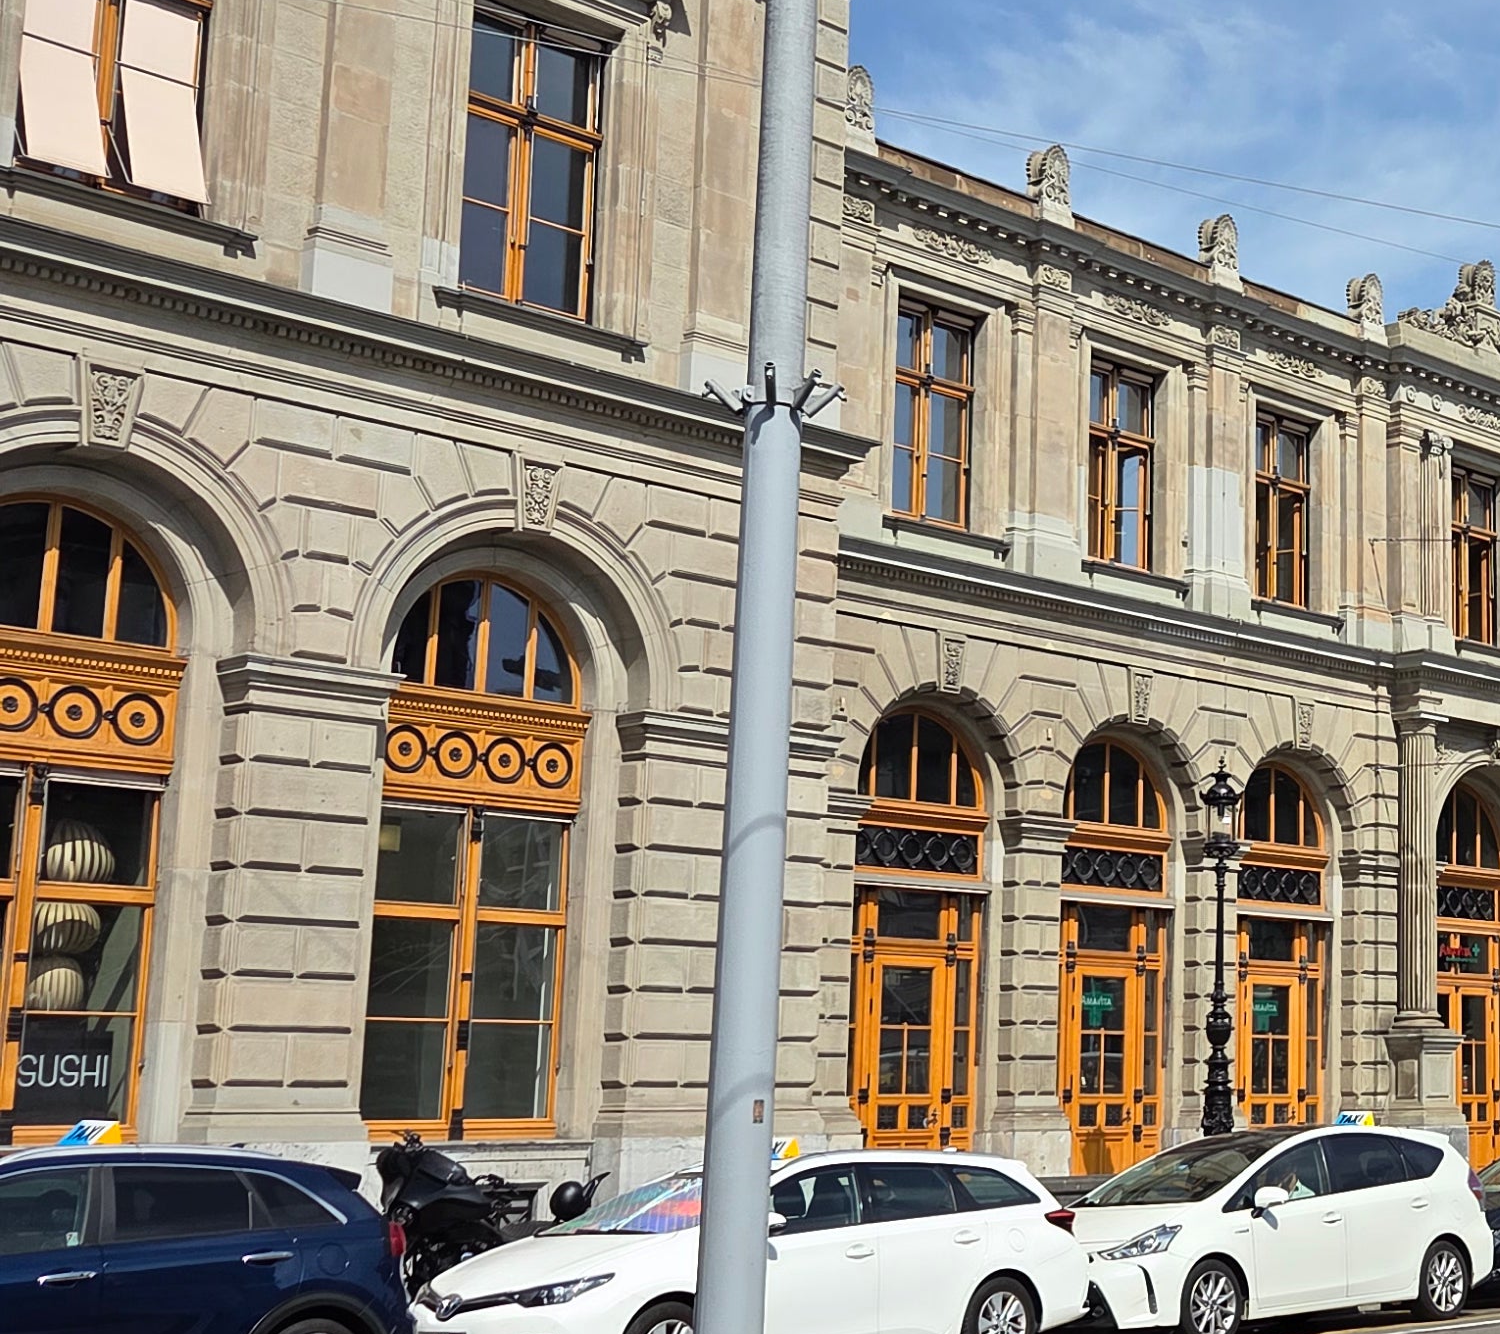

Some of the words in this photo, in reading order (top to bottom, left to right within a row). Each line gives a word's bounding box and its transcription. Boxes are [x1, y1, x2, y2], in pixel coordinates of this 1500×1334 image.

[17, 1054, 109, 1088] SUSHI
[1338, 1114, 1365, 1124] TAXI
[66, 1125, 106, 1142] TAXI
